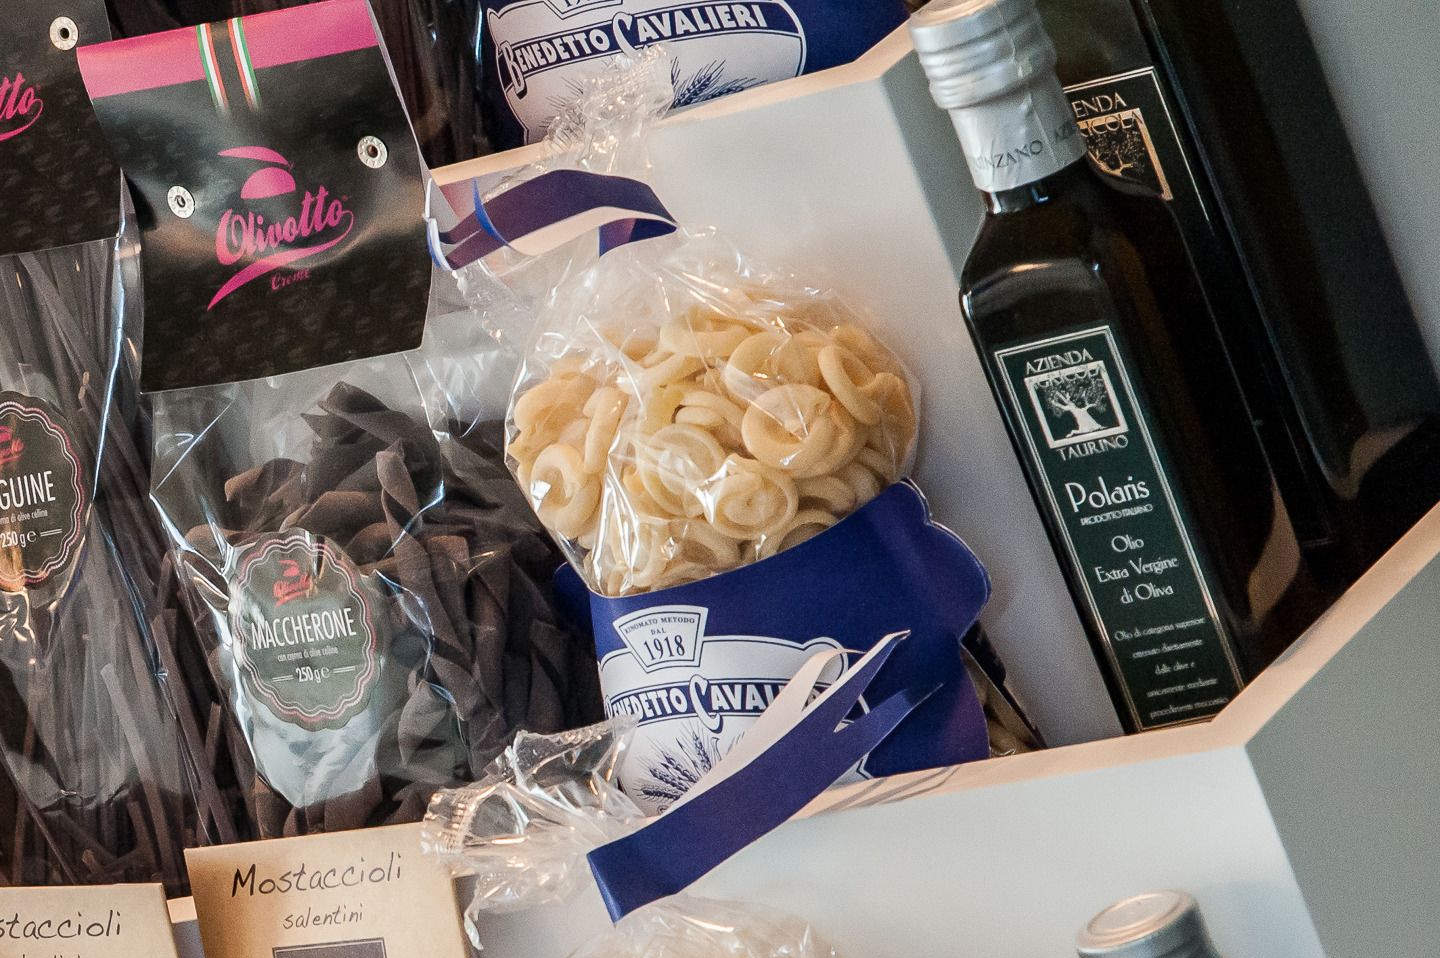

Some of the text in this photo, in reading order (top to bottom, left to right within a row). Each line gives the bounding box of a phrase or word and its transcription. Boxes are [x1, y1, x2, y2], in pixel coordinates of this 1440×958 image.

[500, 2, 768, 99] BENEDETTO CAVALIERI
[1072, 92, 1127, 118] ENDA
[216, 184, 354, 266] Olivotto
[1026, 348, 1093, 375] AZIENDA
[1057, 435, 1128, 461] TAURINO
[1065, 476, 1150, 513] Polaris
[0, 531, 18, 548] 250
[1112, 535, 1144, 552] Olio
[1094, 557, 1179, 584] Extra Vergine
[1120, 582, 1174, 604] di Oliva
[251, 608, 357, 650] MACCHERONE
[650, 628, 666, 636] DAL
[660, 616, 696, 624] METODO
[643, 634, 686, 662] 1918
[296, 666, 313, 682] 250
[232, 852, 402, 897] Mostaccioli
[282, 904, 363, 930] salentini
